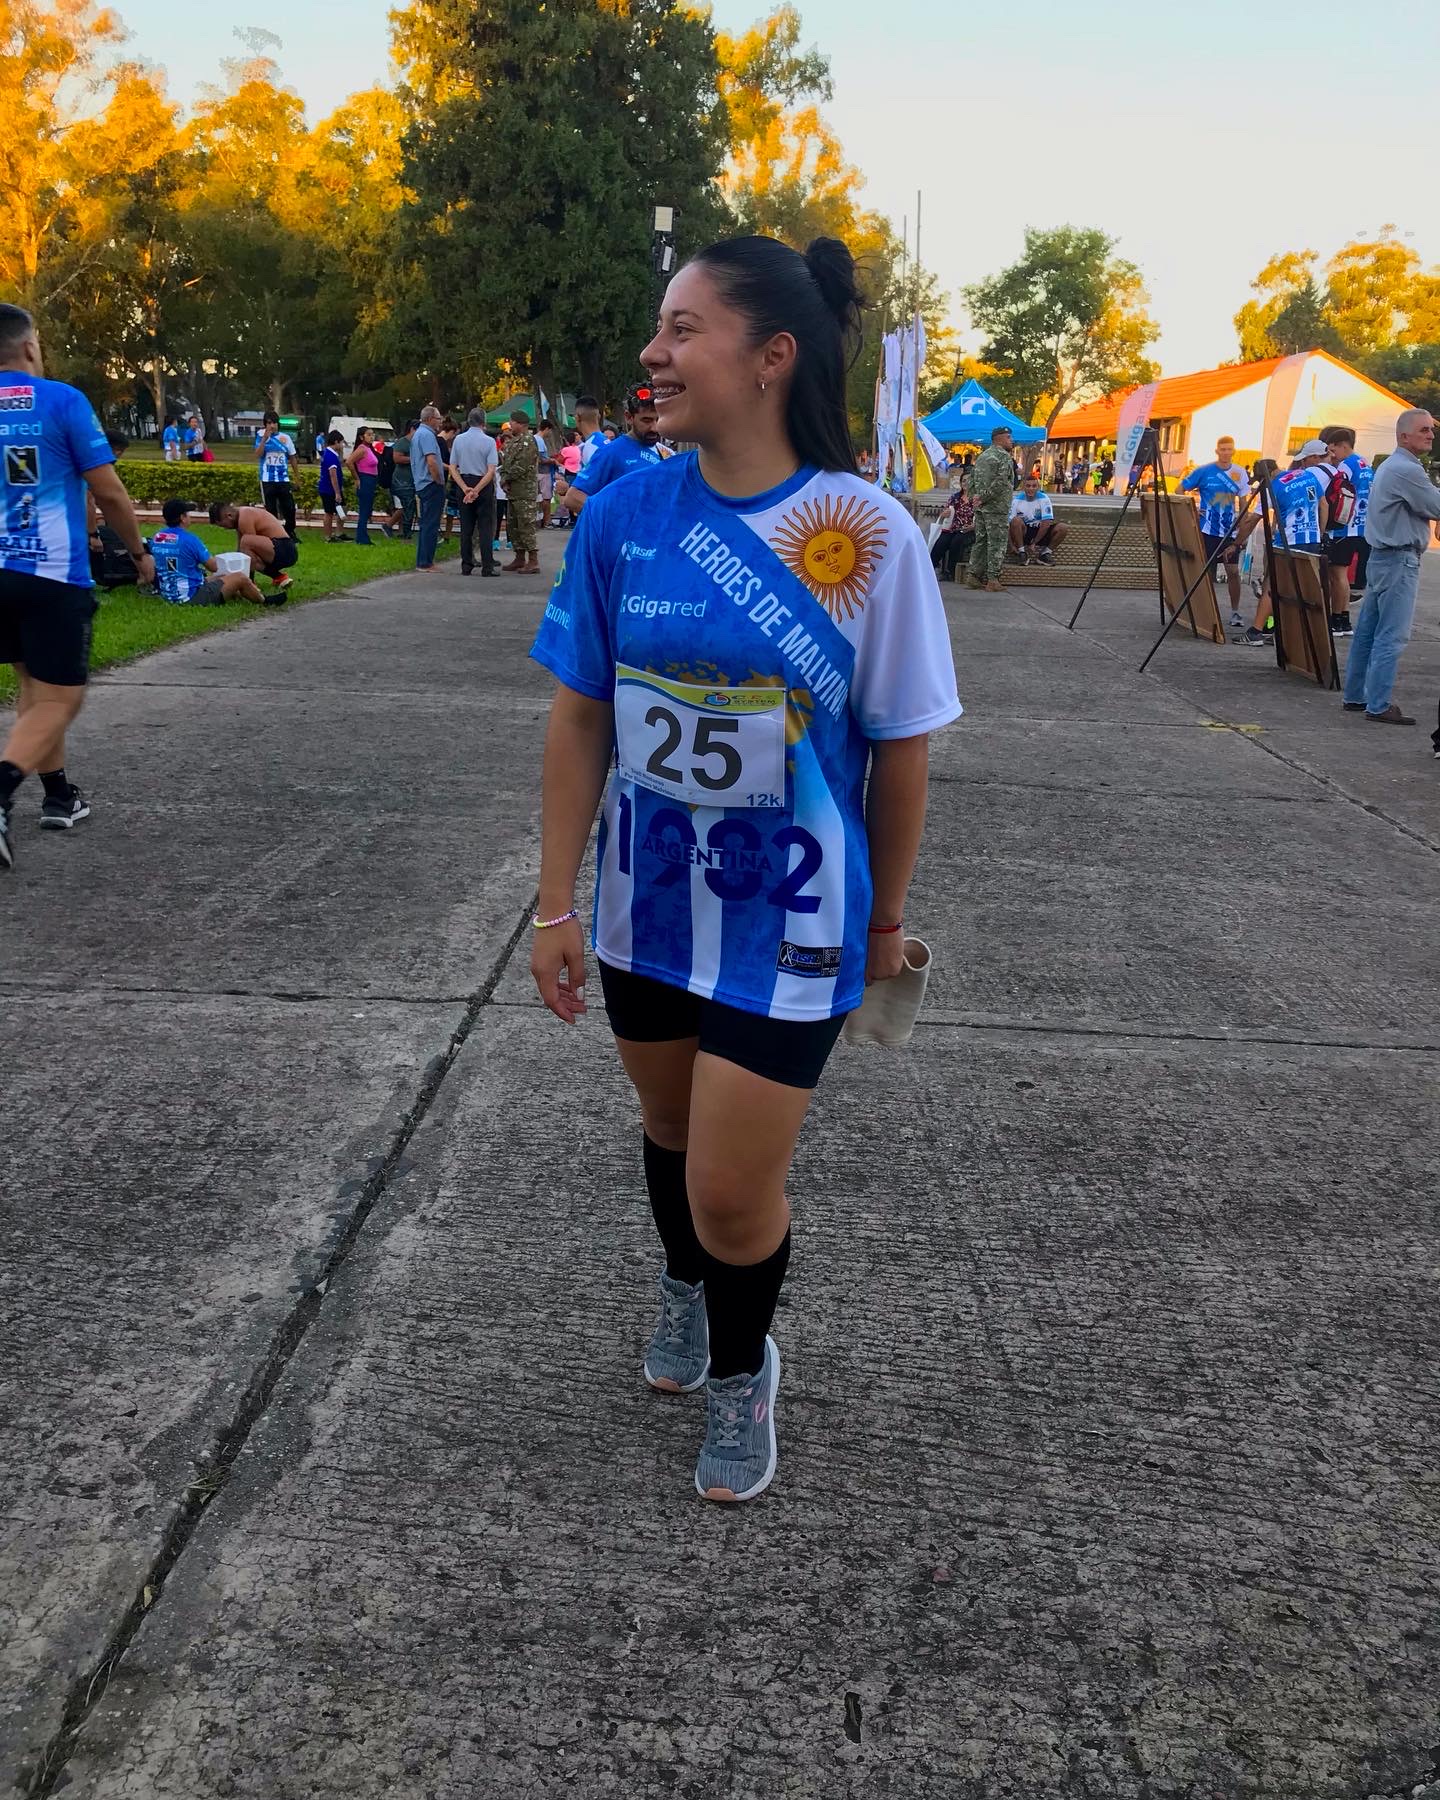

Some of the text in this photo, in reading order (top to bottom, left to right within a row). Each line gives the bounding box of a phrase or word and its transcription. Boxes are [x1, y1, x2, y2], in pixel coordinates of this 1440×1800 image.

[0, 420, 42, 436] ared
[268, 455, 284, 465] 176
[627, 595, 707, 618] Gigared
[679, 522, 849, 722] HEROES DE MALVINA
[644, 706, 743, 791] 25
[618, 793, 823, 914] 1982
[642, 836, 773, 874] ARGENTINA
